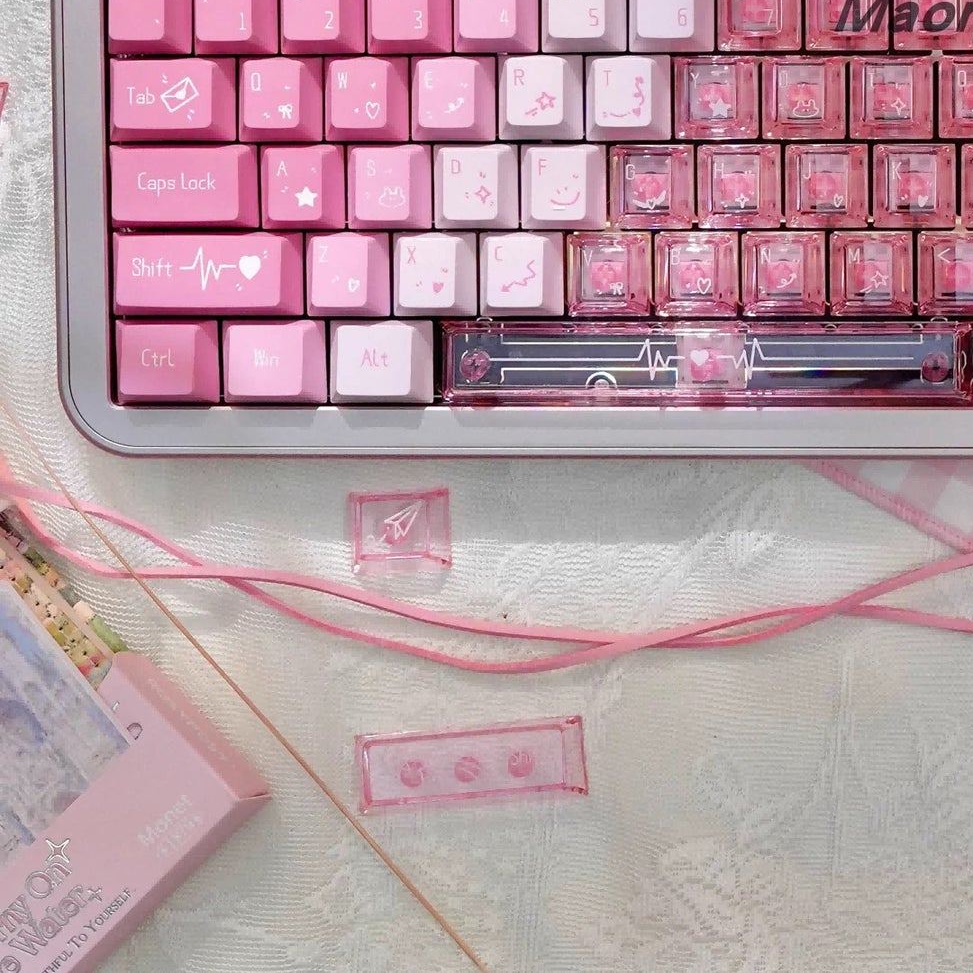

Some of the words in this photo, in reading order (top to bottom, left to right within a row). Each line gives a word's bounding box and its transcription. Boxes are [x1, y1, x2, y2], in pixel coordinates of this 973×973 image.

[238, 12, 247, 31] 1
[325, 11, 334, 29] 2
[413, 11, 423, 29] 3
[499, 9, 510, 26] 4
[589, 8, 599, 27] 5
[677, 8, 687, 27] 6
[251, 73, 261, 92] Q
[338, 72, 348, 89] W
[424, 71, 433, 88] E
[514, 69, 525, 85] R
[603, 69, 612, 85] T
[690, 72, 699, 88] Y
[127, 86, 155, 105] Tab
[276, 161, 287, 177] A
[367, 160, 376, 177] S
[452, 159, 461, 175] D
[538, 161, 546, 176] F
[714, 163, 723, 179] H
[803, 163, 812, 180] J
[892, 162, 901, 179] K
[137, 173, 176, 198] Caps
[181, 173, 216, 190] Lock
[319, 246, 329, 263] Z
[407, 247, 416, 263] X
[495, 246, 503, 262] C
[583, 249, 592, 264] V
[671, 249, 681, 265] B
[760, 248, 771, 264] N
[849, 248, 860, 263] M
[132, 258, 171, 277] Shift
[141, 349, 175, 367] Ctrl
[253, 349, 279, 367] Win
[361, 349, 388, 367] Alt
[25, 863, 72, 900] On
[8, 885, 88, 956] Water
[67, 933, 88, 950] To
